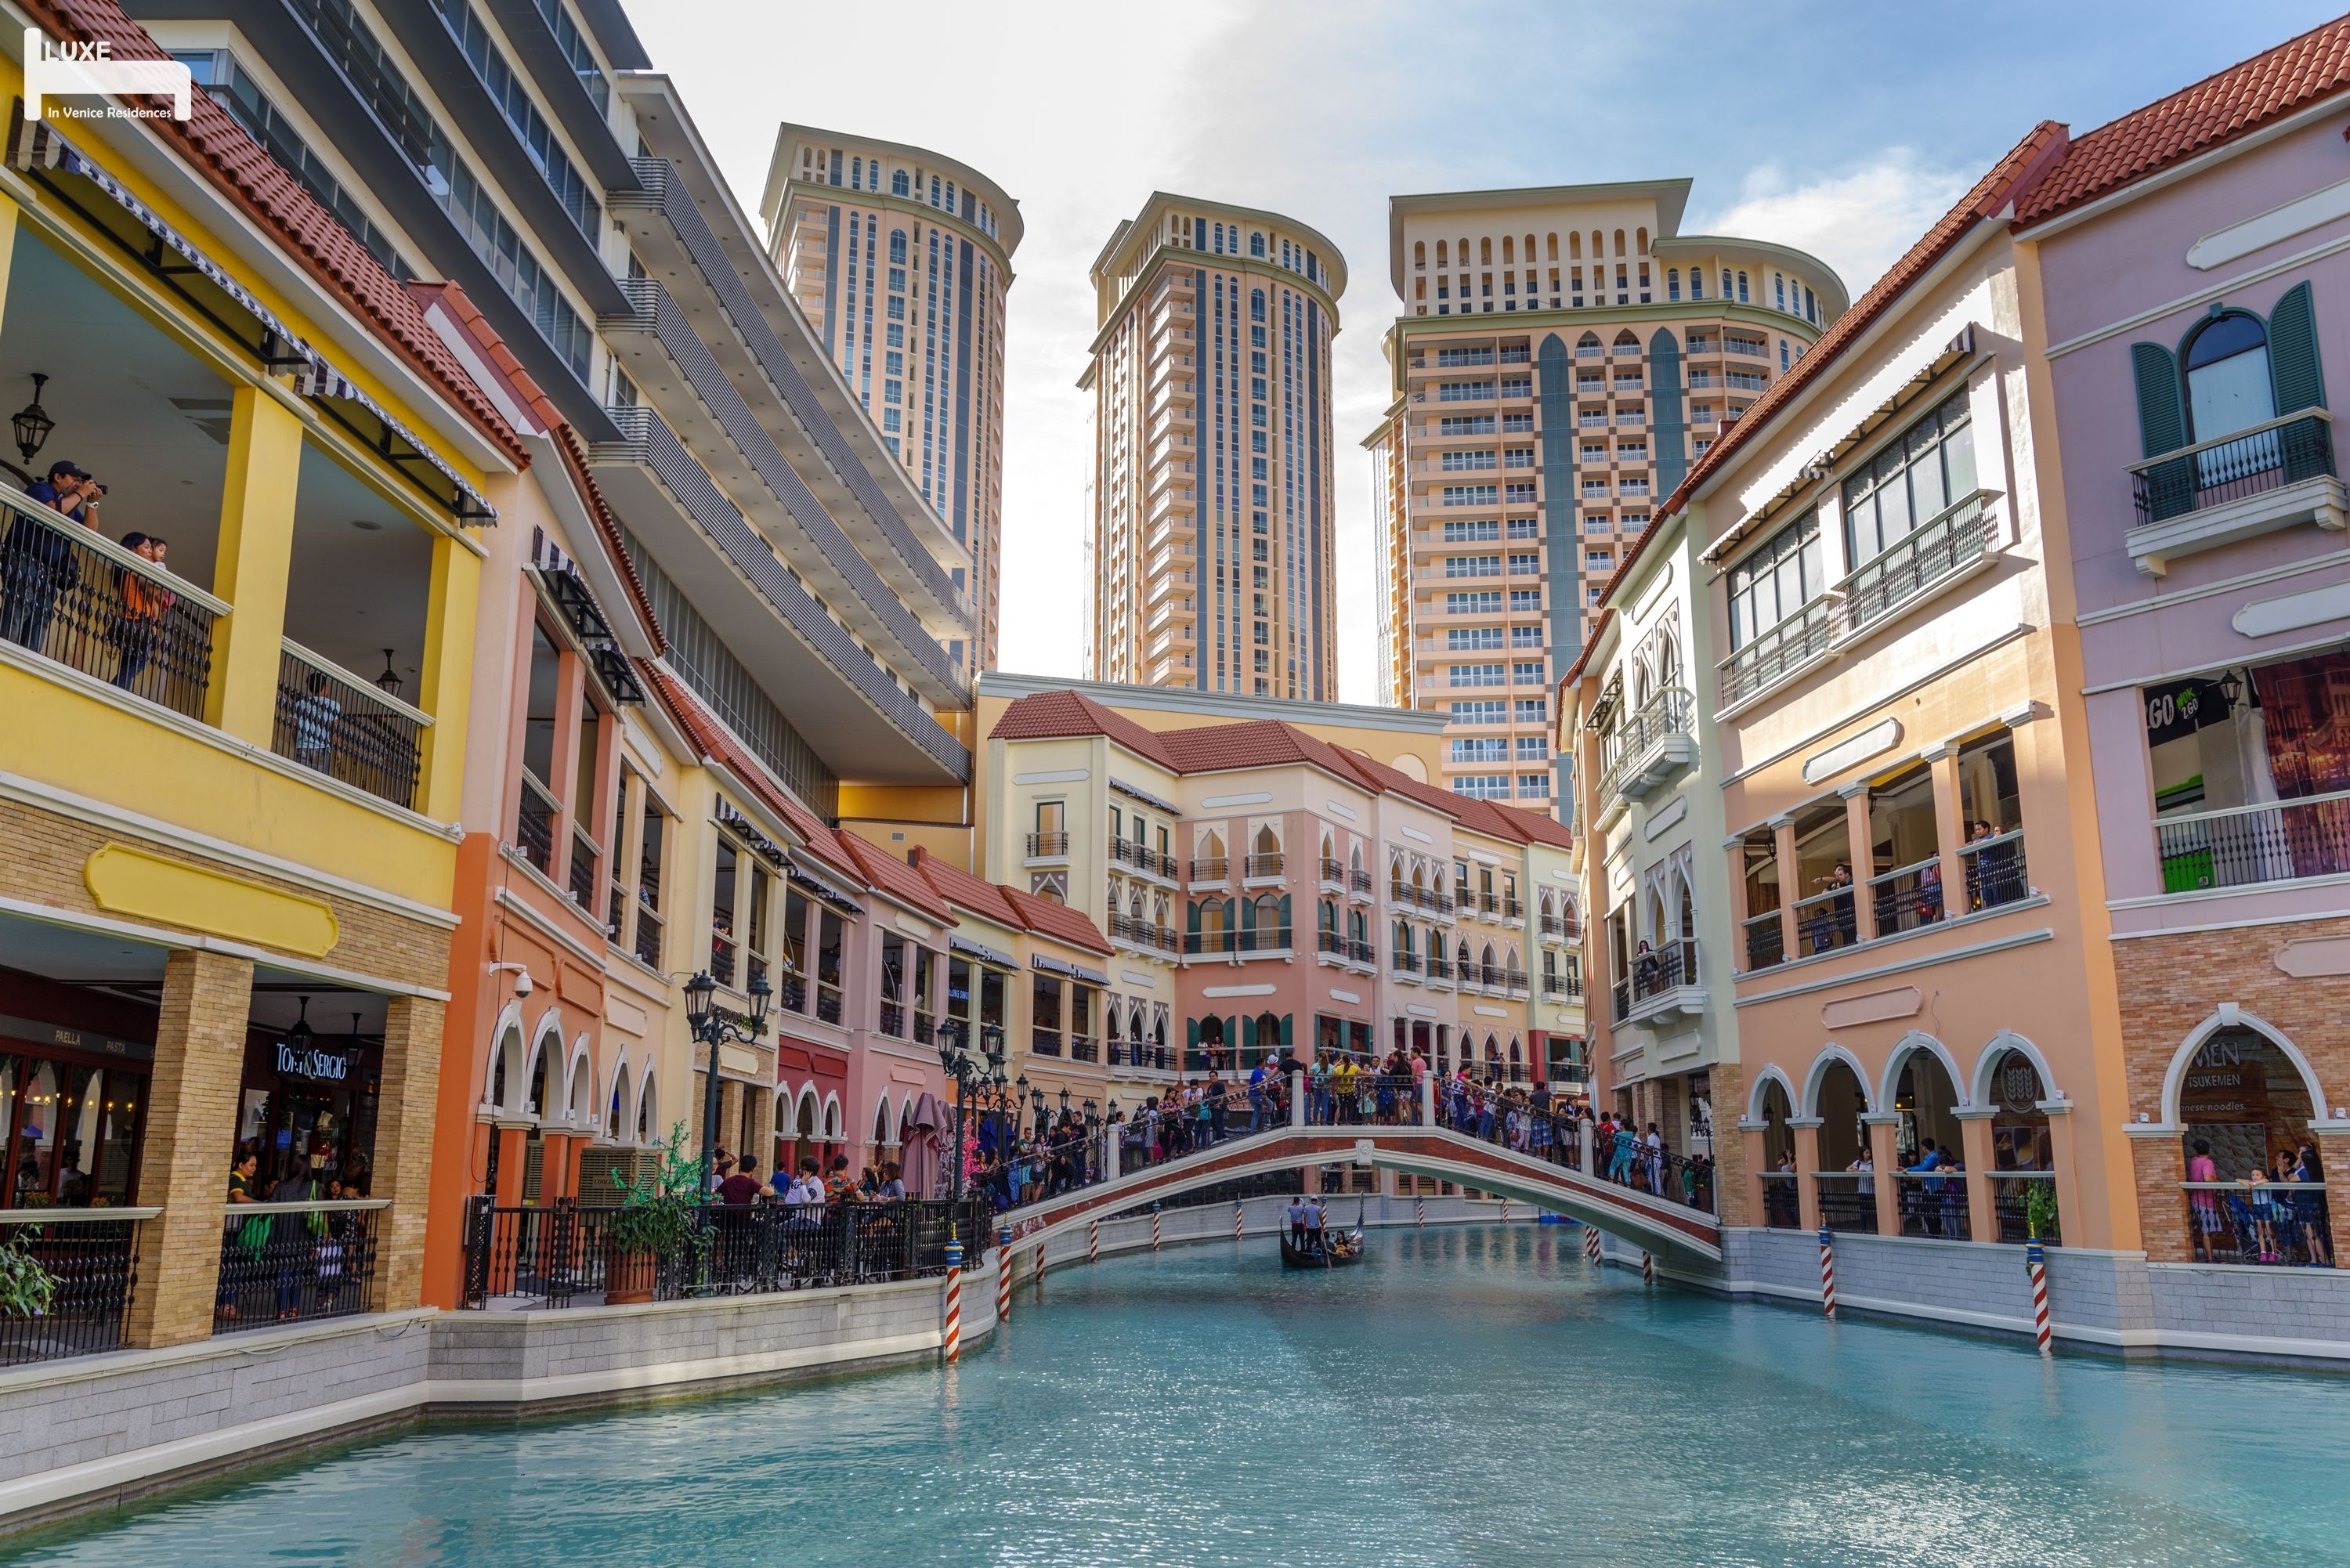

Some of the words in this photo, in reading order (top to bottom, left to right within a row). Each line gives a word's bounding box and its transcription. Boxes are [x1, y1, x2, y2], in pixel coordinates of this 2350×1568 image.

[2176, 687, 2196, 710] WOK
[2146, 694, 2175, 729] GO
[55, 1029, 81, 1046] PAELLA
[107, 1040, 125, 1055] PASTA
[313, 1049, 346, 1079] SERGIO
[2188, 1074, 2240, 1088] TSUKEMEN
[2207, 1101, 2247, 1111] noodles.
